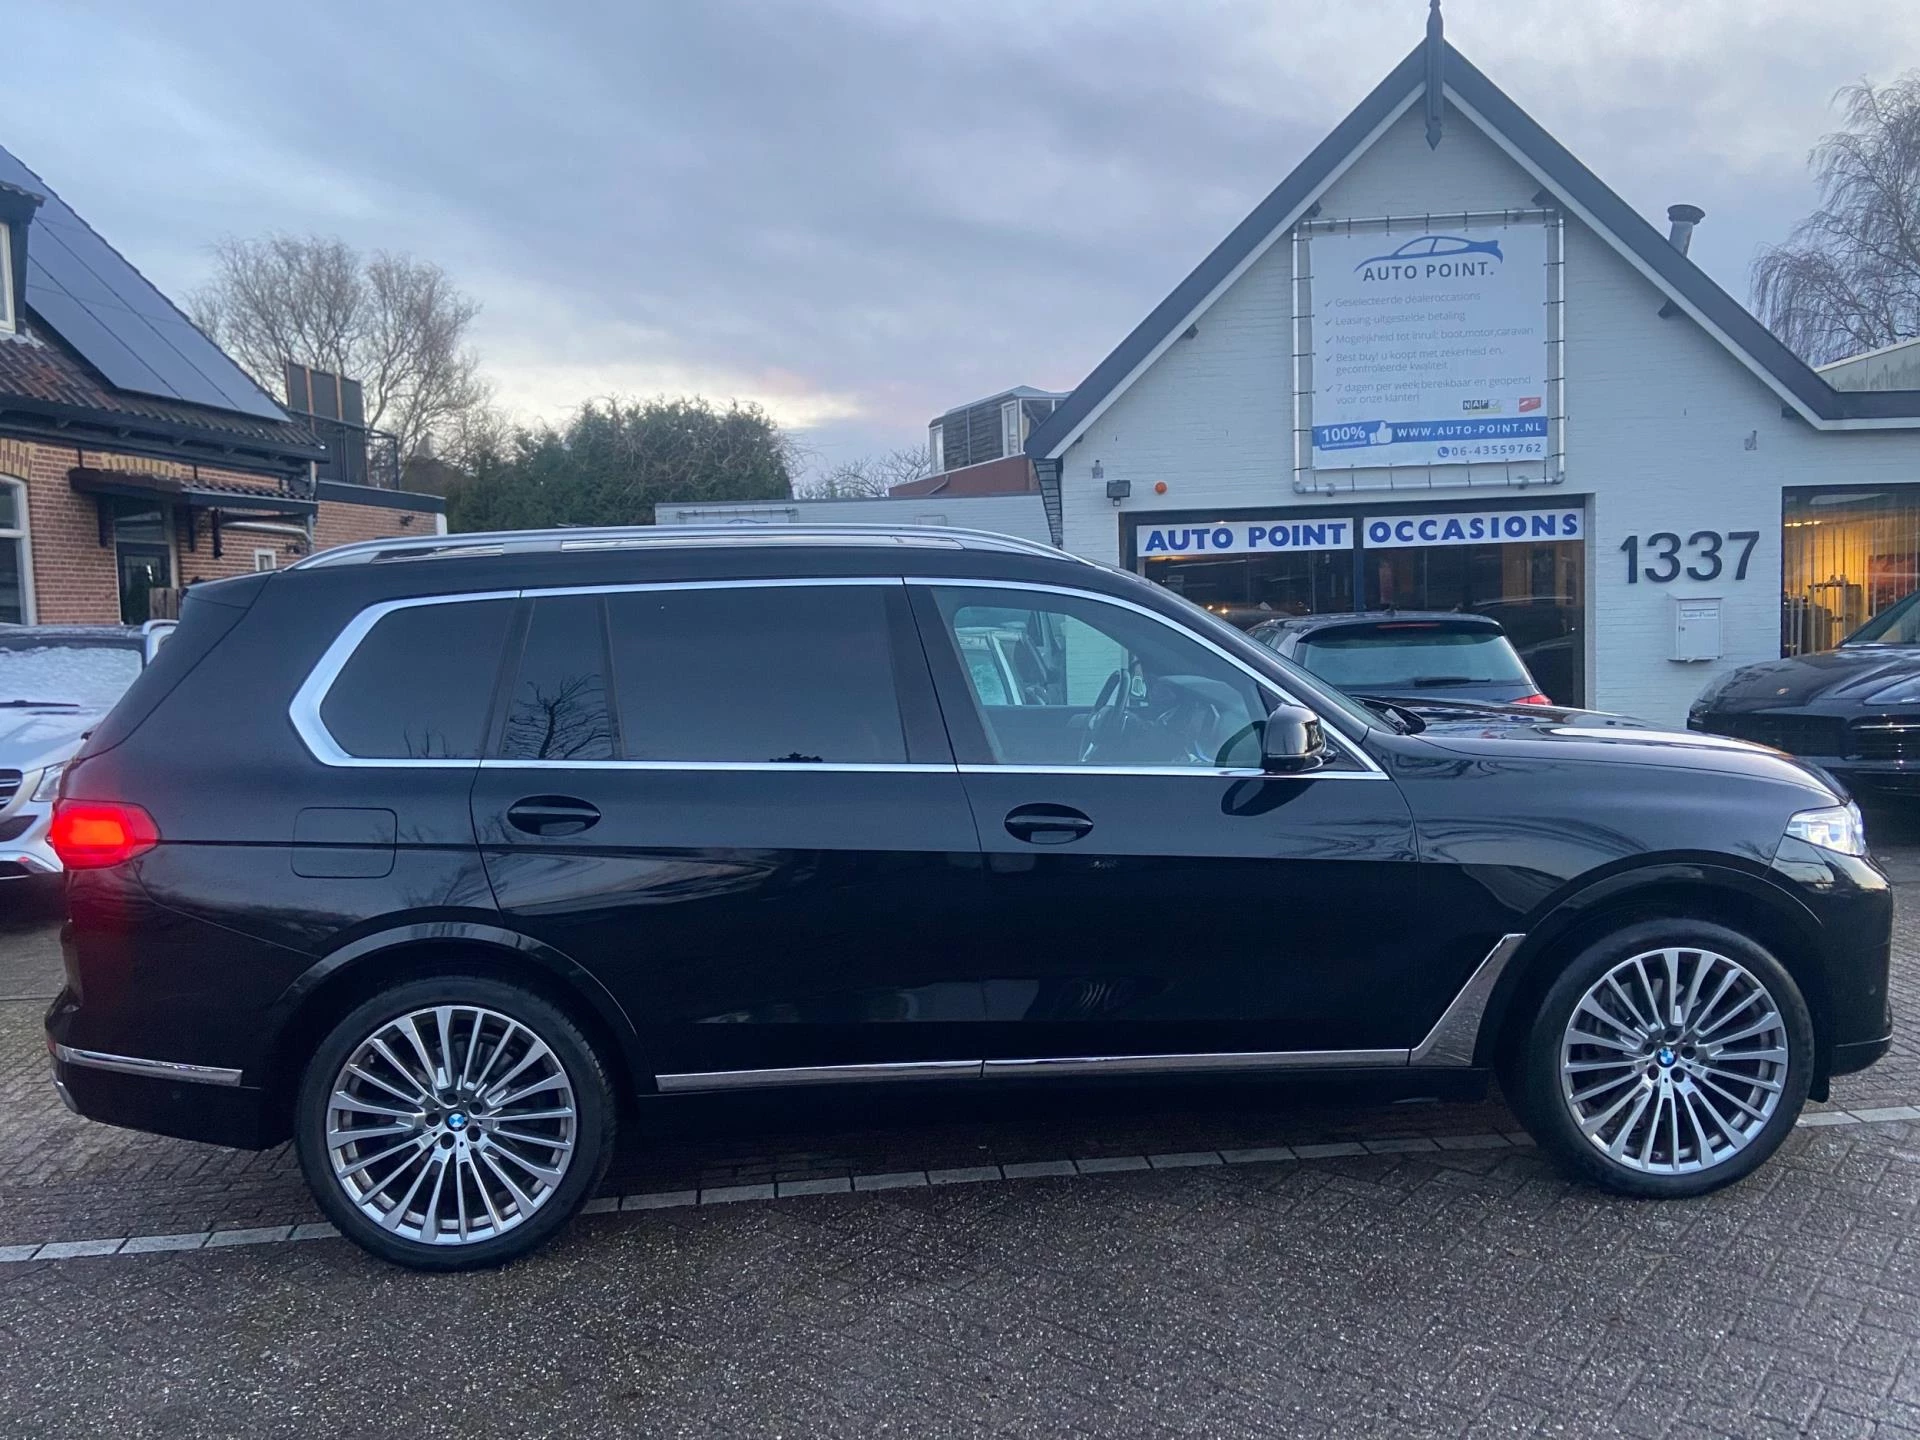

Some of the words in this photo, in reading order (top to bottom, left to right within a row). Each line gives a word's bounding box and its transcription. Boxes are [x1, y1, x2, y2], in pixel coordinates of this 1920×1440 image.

[1363, 266, 1417, 281] AUTO
[1336, 353, 1357, 362] Best
[1336, 384, 1343, 392] 7
[1344, 382, 1374, 394] dagen
[1376, 383, 1393, 393] per
[1322, 426, 1366, 442] 100%
[1397, 422, 1541, 437] WWW.AUTO-POINT.NL
[1451, 443, 1542, 456] 06-43559762
[1369, 513, 1578, 543] OCCASIONS
[1145, 527, 1234, 552] AUTO
[1248, 523, 1346, 548] POINT
[1620, 531, 1760, 584] 1337
